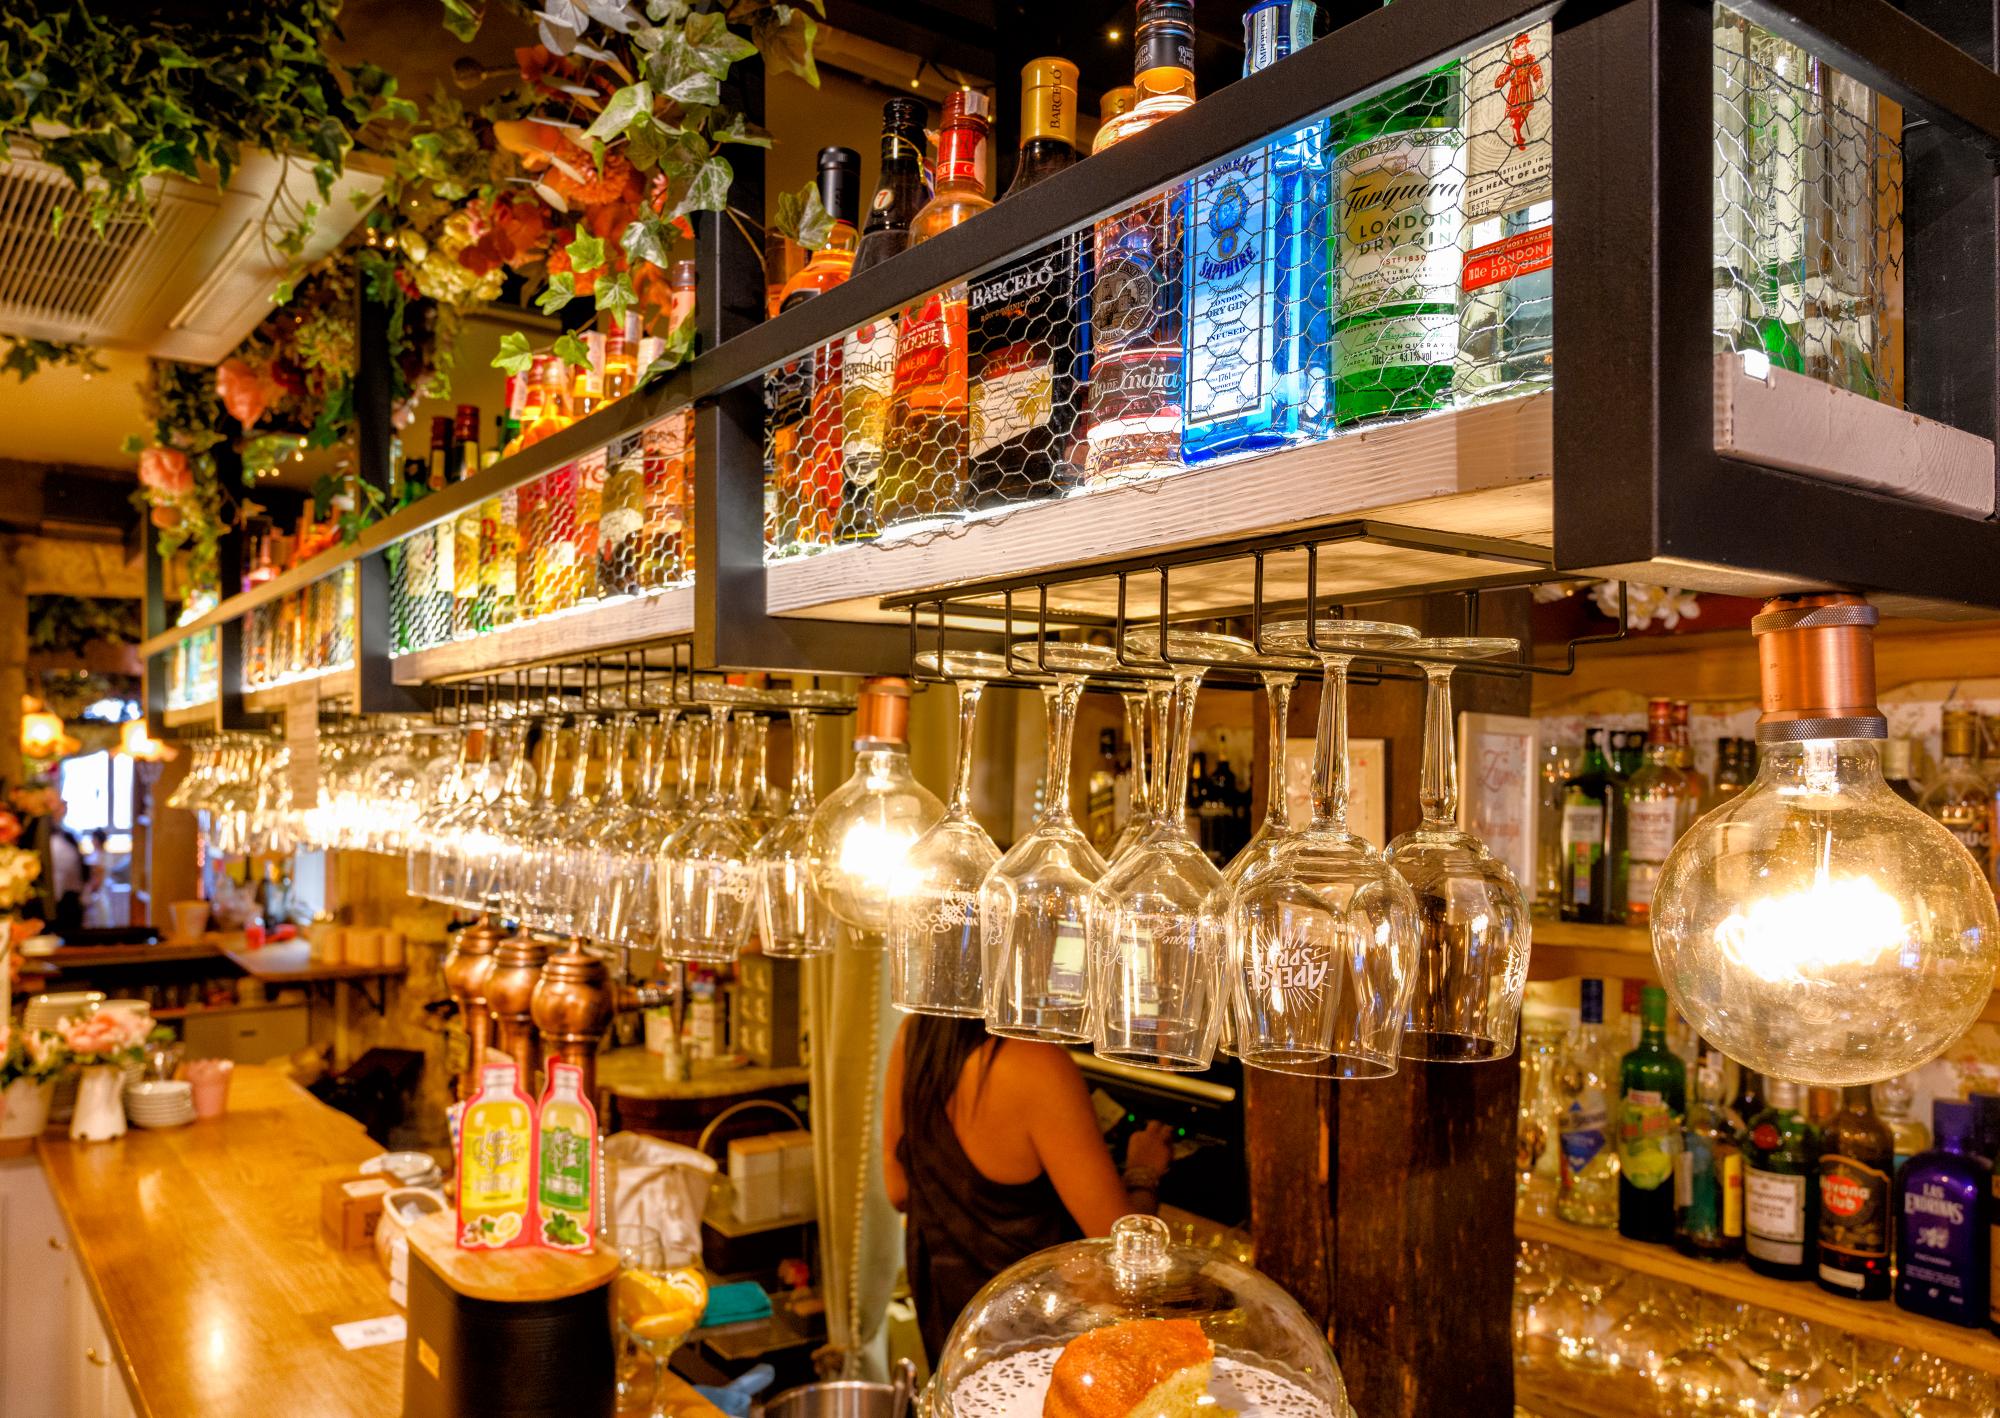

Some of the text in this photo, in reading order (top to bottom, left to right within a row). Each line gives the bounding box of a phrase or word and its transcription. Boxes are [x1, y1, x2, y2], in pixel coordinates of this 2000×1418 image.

[1049, 69, 1063, 129] BARCELÓ
[1468, 185, 1484, 198] THE
[1486, 175, 1514, 193] HEART
[1517, 170, 1530, 180] OF
[1532, 163, 1553, 175] LON
[1344, 183, 1459, 219] Tanquera
[1360, 213, 1452, 239] LONDON
[1524, 231, 1553, 244] AWARDE
[1360, 231, 1452, 256] DRY GIN
[1491, 243, 1544, 268] LONDON
[1491, 263, 1516, 279] DRY
